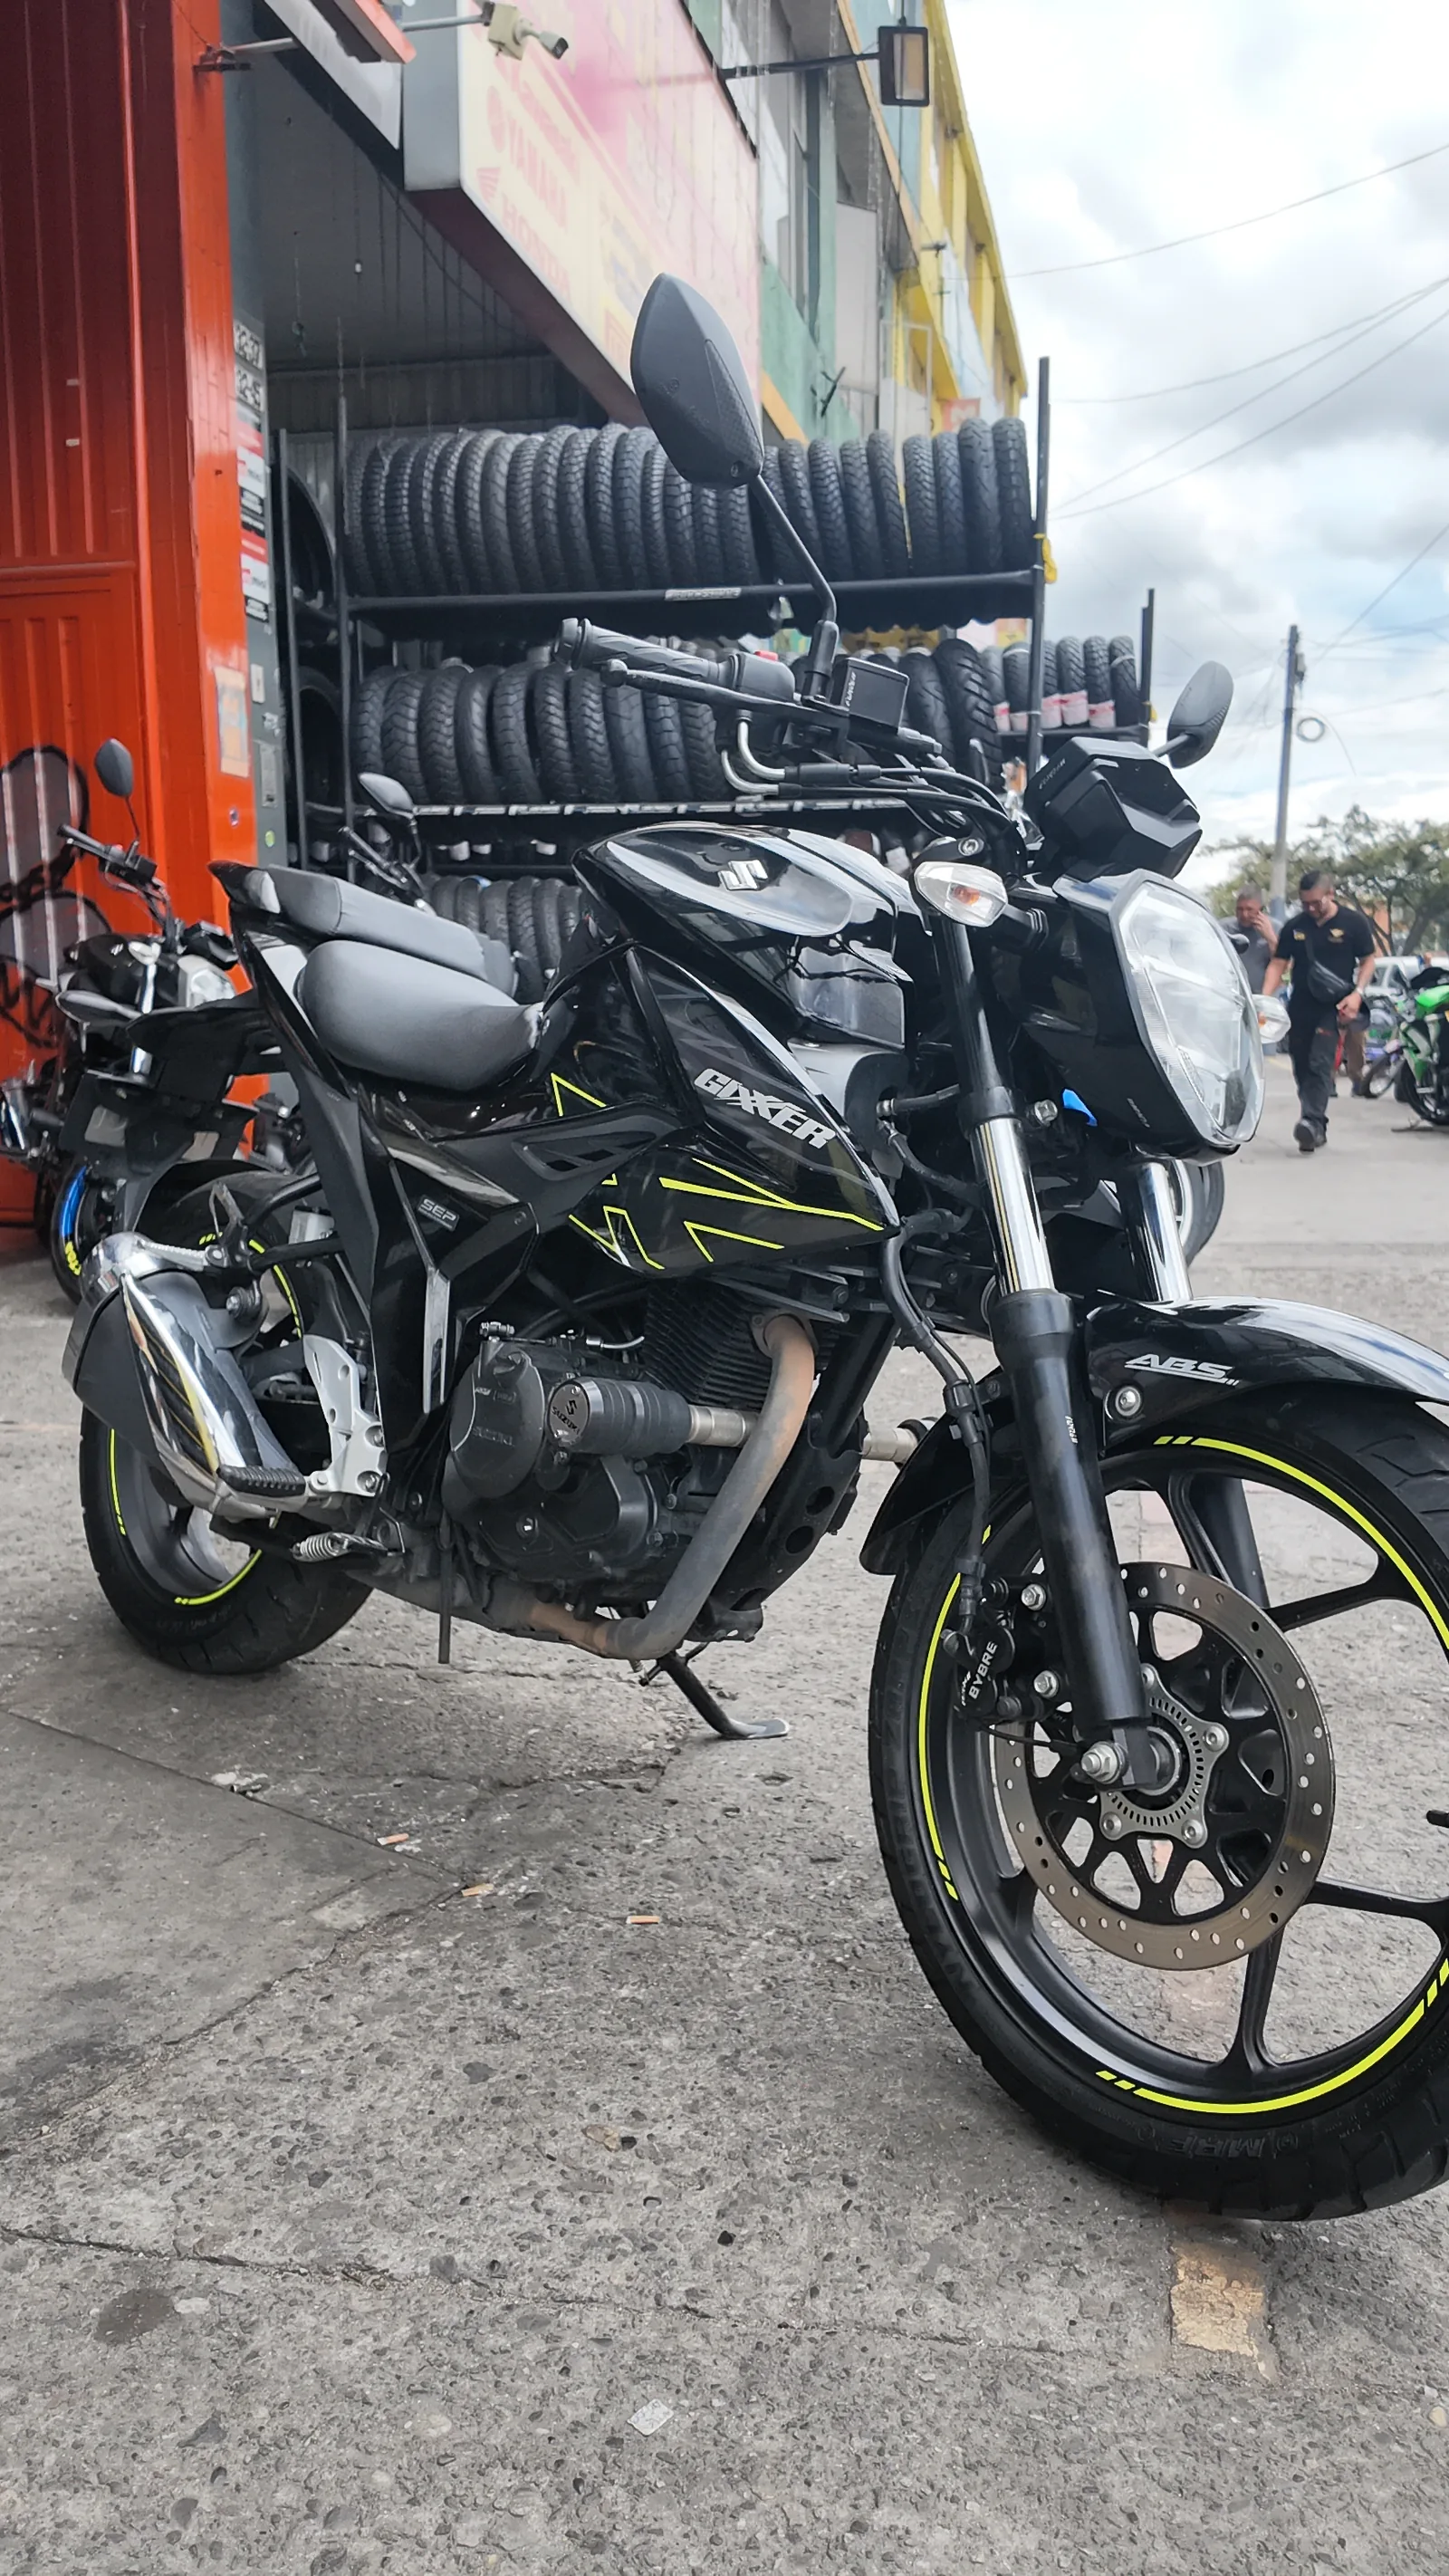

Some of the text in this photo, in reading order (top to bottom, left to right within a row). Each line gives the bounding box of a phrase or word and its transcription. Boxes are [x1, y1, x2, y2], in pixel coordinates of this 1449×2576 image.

[500, 191, 572, 306] HONDA
[694, 1068, 837, 1149] GIXXER
[419, 1198, 456, 1222] SEP
[1125, 1353, 1233, 1380] ABS
[552, 1406, 580, 1436] SUZUKI
[968, 1640, 998, 1700] BYBRE
[1166, 2134, 1267, 2159] MRF
